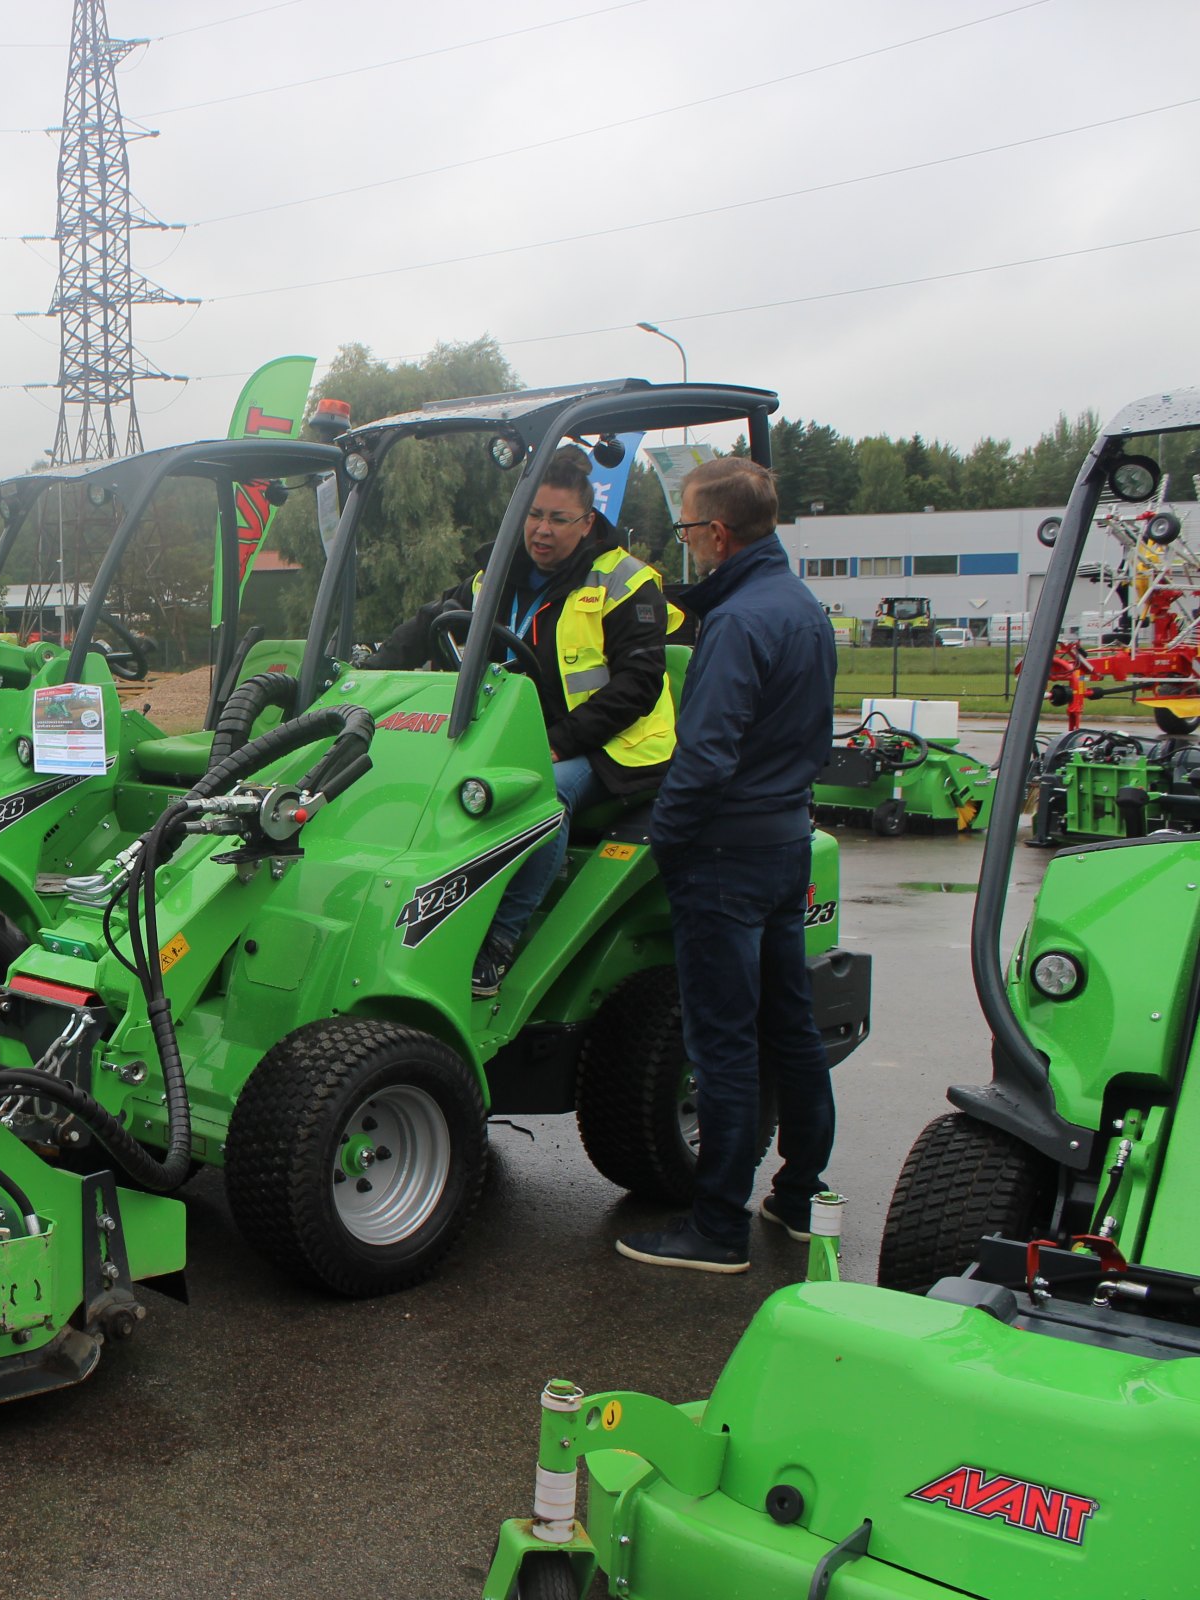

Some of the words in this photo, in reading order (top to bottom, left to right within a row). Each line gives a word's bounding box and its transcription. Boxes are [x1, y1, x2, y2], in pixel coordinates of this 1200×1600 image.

[374, 711, 450, 734] AVANT
[395, 874, 467, 928] 423
[904, 1464, 1097, 1547] AVANT
